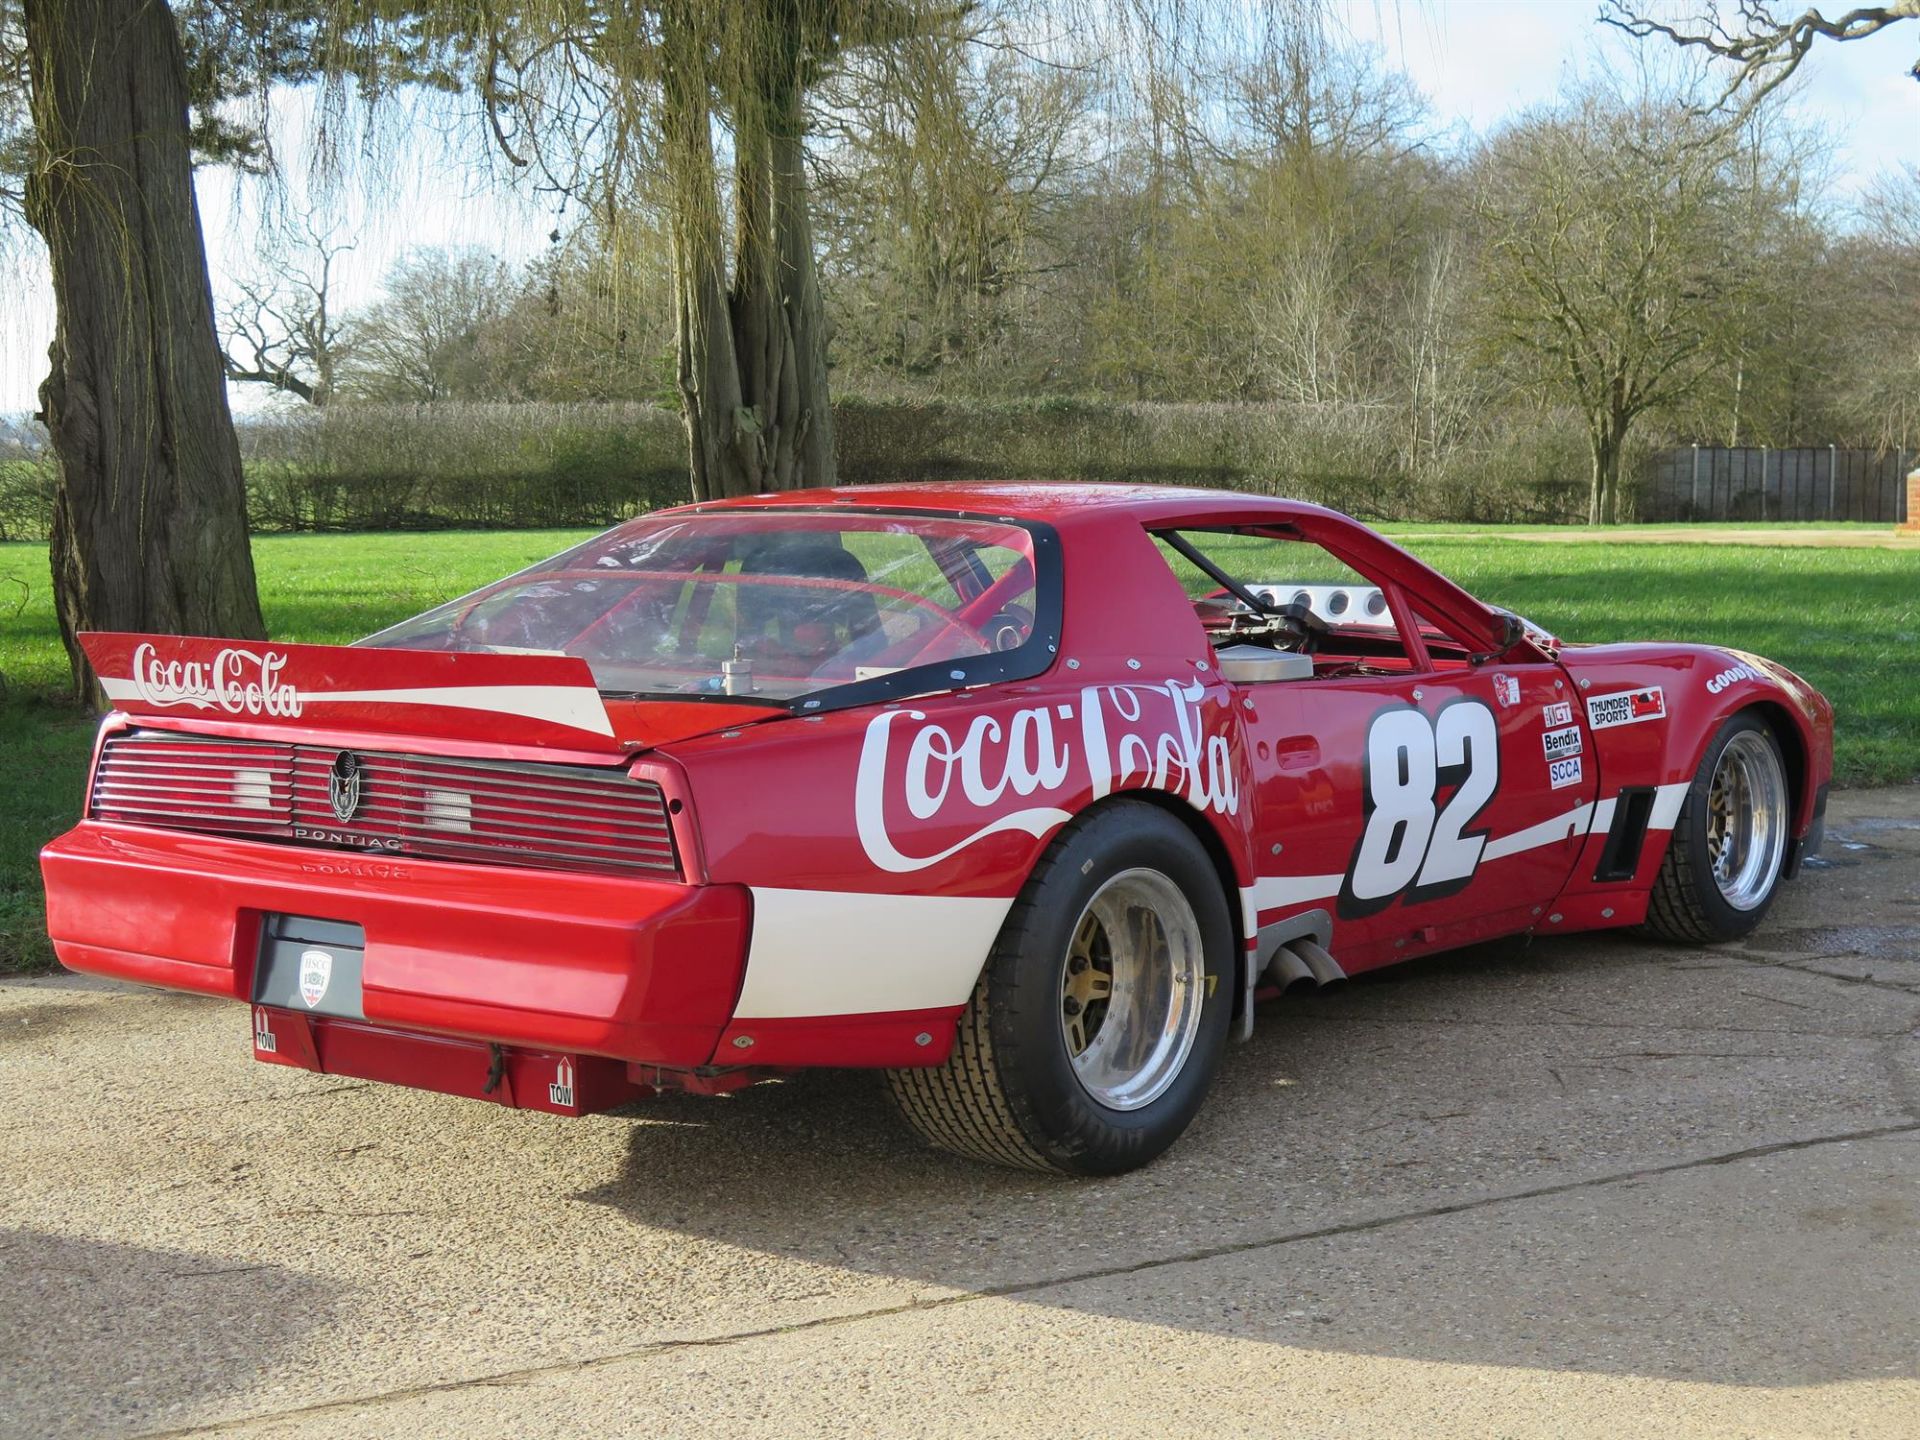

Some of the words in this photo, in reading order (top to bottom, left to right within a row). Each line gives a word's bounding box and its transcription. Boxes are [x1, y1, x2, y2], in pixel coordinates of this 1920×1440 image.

[133, 642, 303, 719] Coca-Cola
[1590, 696, 1630, 715] THUNDER
[1594, 708, 1629, 726] SPORTS
[1543, 728, 1579, 751] Bendix
[854, 674, 1240, 874] Coca-Cola
[1551, 759, 1581, 782] SCCA
[1351, 700, 1498, 901] 82
[294, 827, 401, 850] PONTIAC
[304, 958, 329, 970] HSCC
[257, 1031, 275, 1051] TOW
[550, 1084, 572, 1105] TOW
